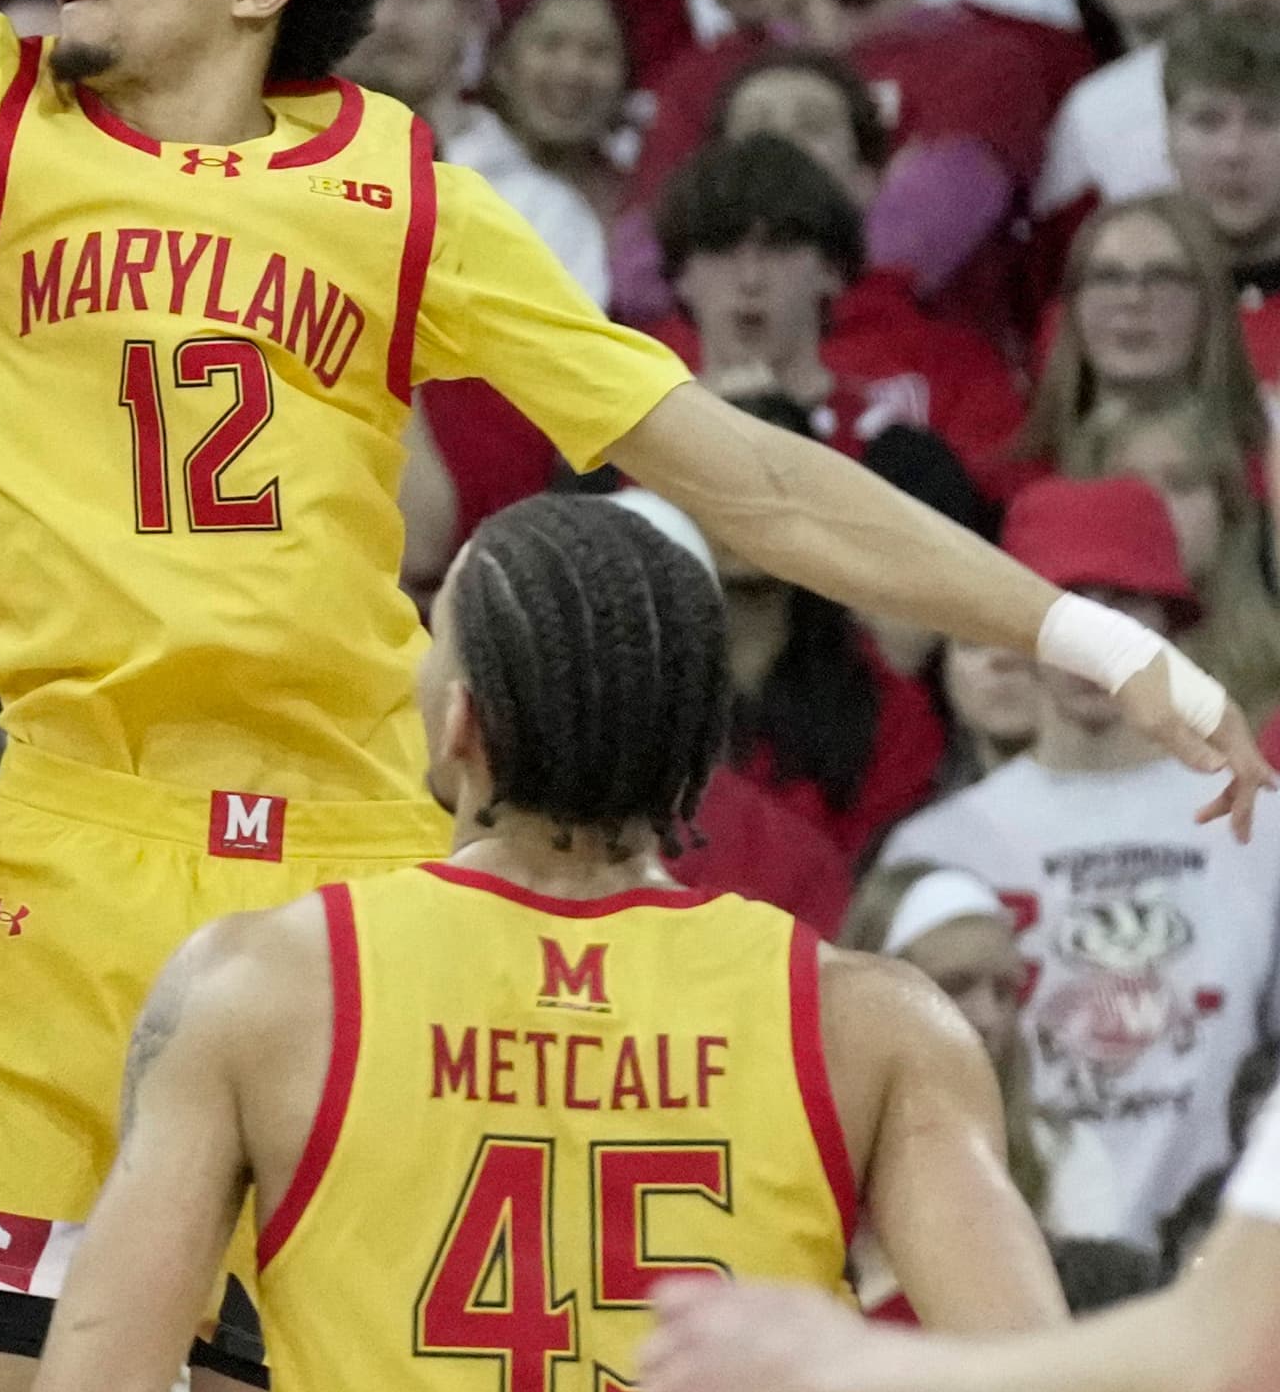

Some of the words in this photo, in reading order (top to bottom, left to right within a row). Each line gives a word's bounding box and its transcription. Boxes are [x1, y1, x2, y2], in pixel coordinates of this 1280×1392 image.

[19, 228, 366, 389] MARYLAND
[118, 339, 283, 535] 12
[223, 794, 273, 844] M
[536, 935, 610, 1005] M
[429, 1022, 729, 1111] METCALF
